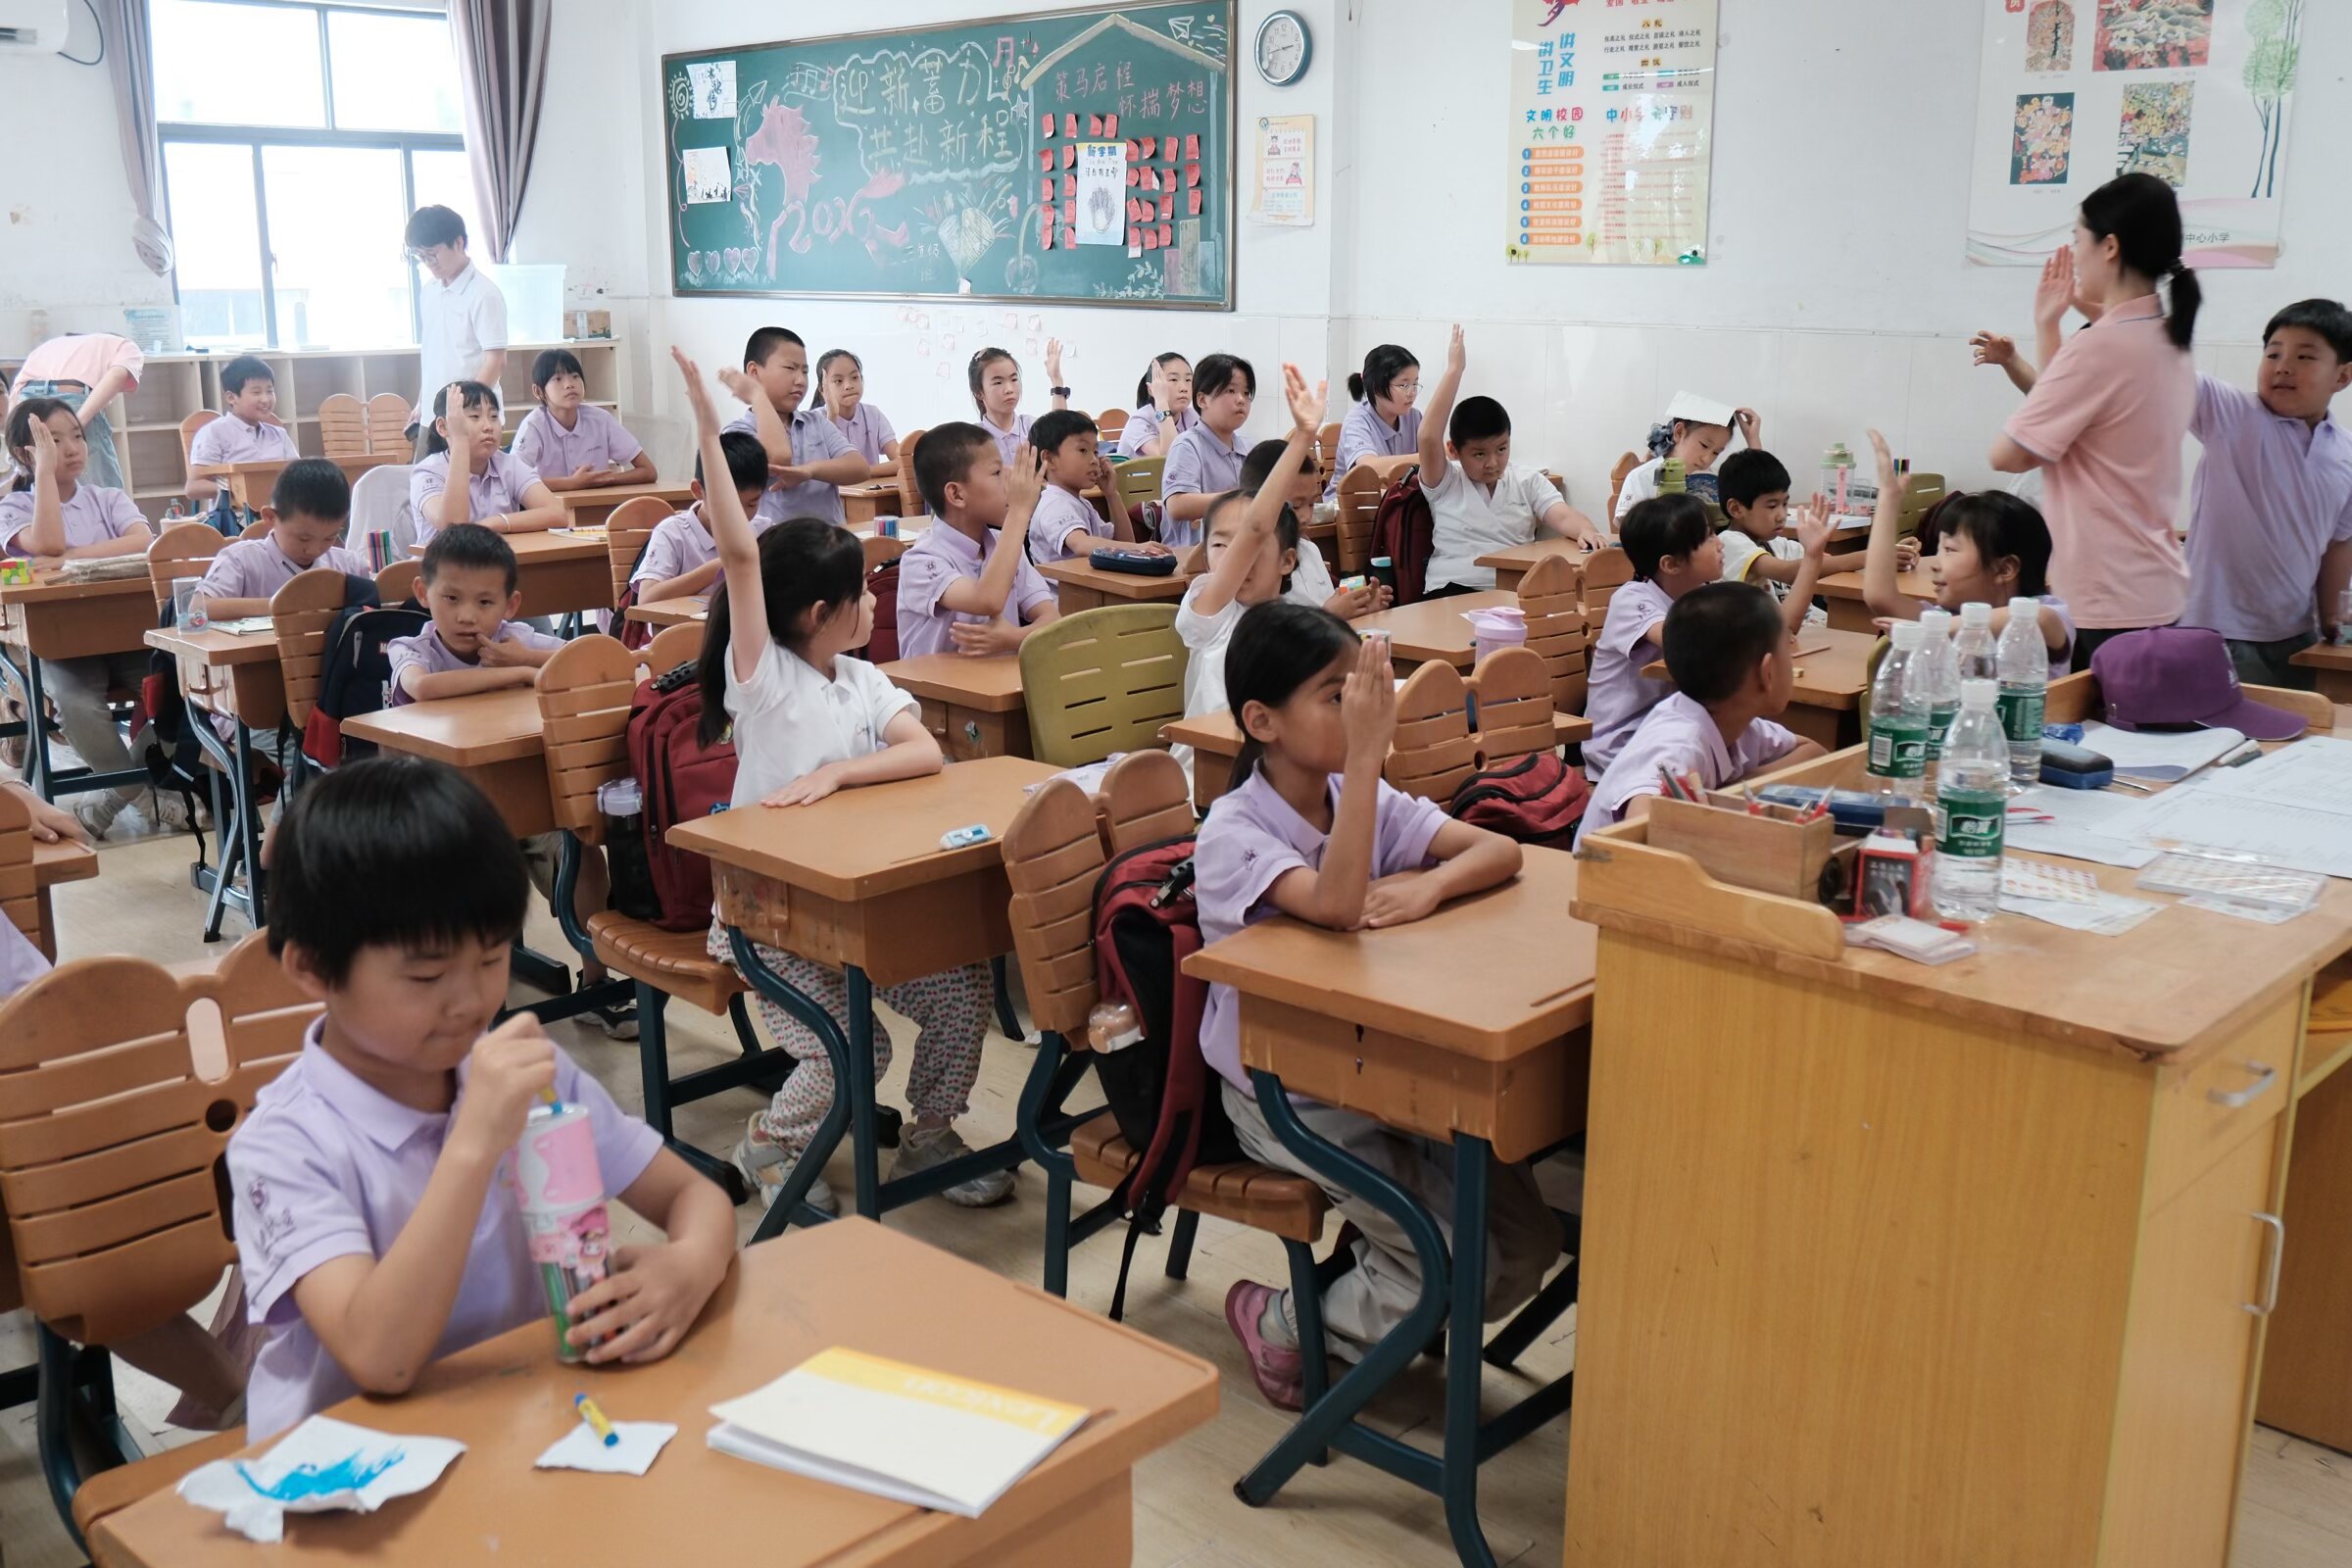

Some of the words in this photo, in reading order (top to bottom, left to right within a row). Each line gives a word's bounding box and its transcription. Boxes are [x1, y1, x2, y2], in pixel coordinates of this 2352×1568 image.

[1537, 40, 1554, 95] 讲卫生
[1557, 32, 1576, 87] 讲文明
[839, 49, 982, 116] 迎新蓄力
[1054, 61, 1136, 103] 策马启程
[1118, 79, 1207, 121] 怀揣梦想
[1526, 107, 1584, 122] 文明校园
[1533, 125, 1575, 139] 六个好
[868, 110, 1013, 171] 共赴新程
[2184, 231, 2230, 243] 中心小学
